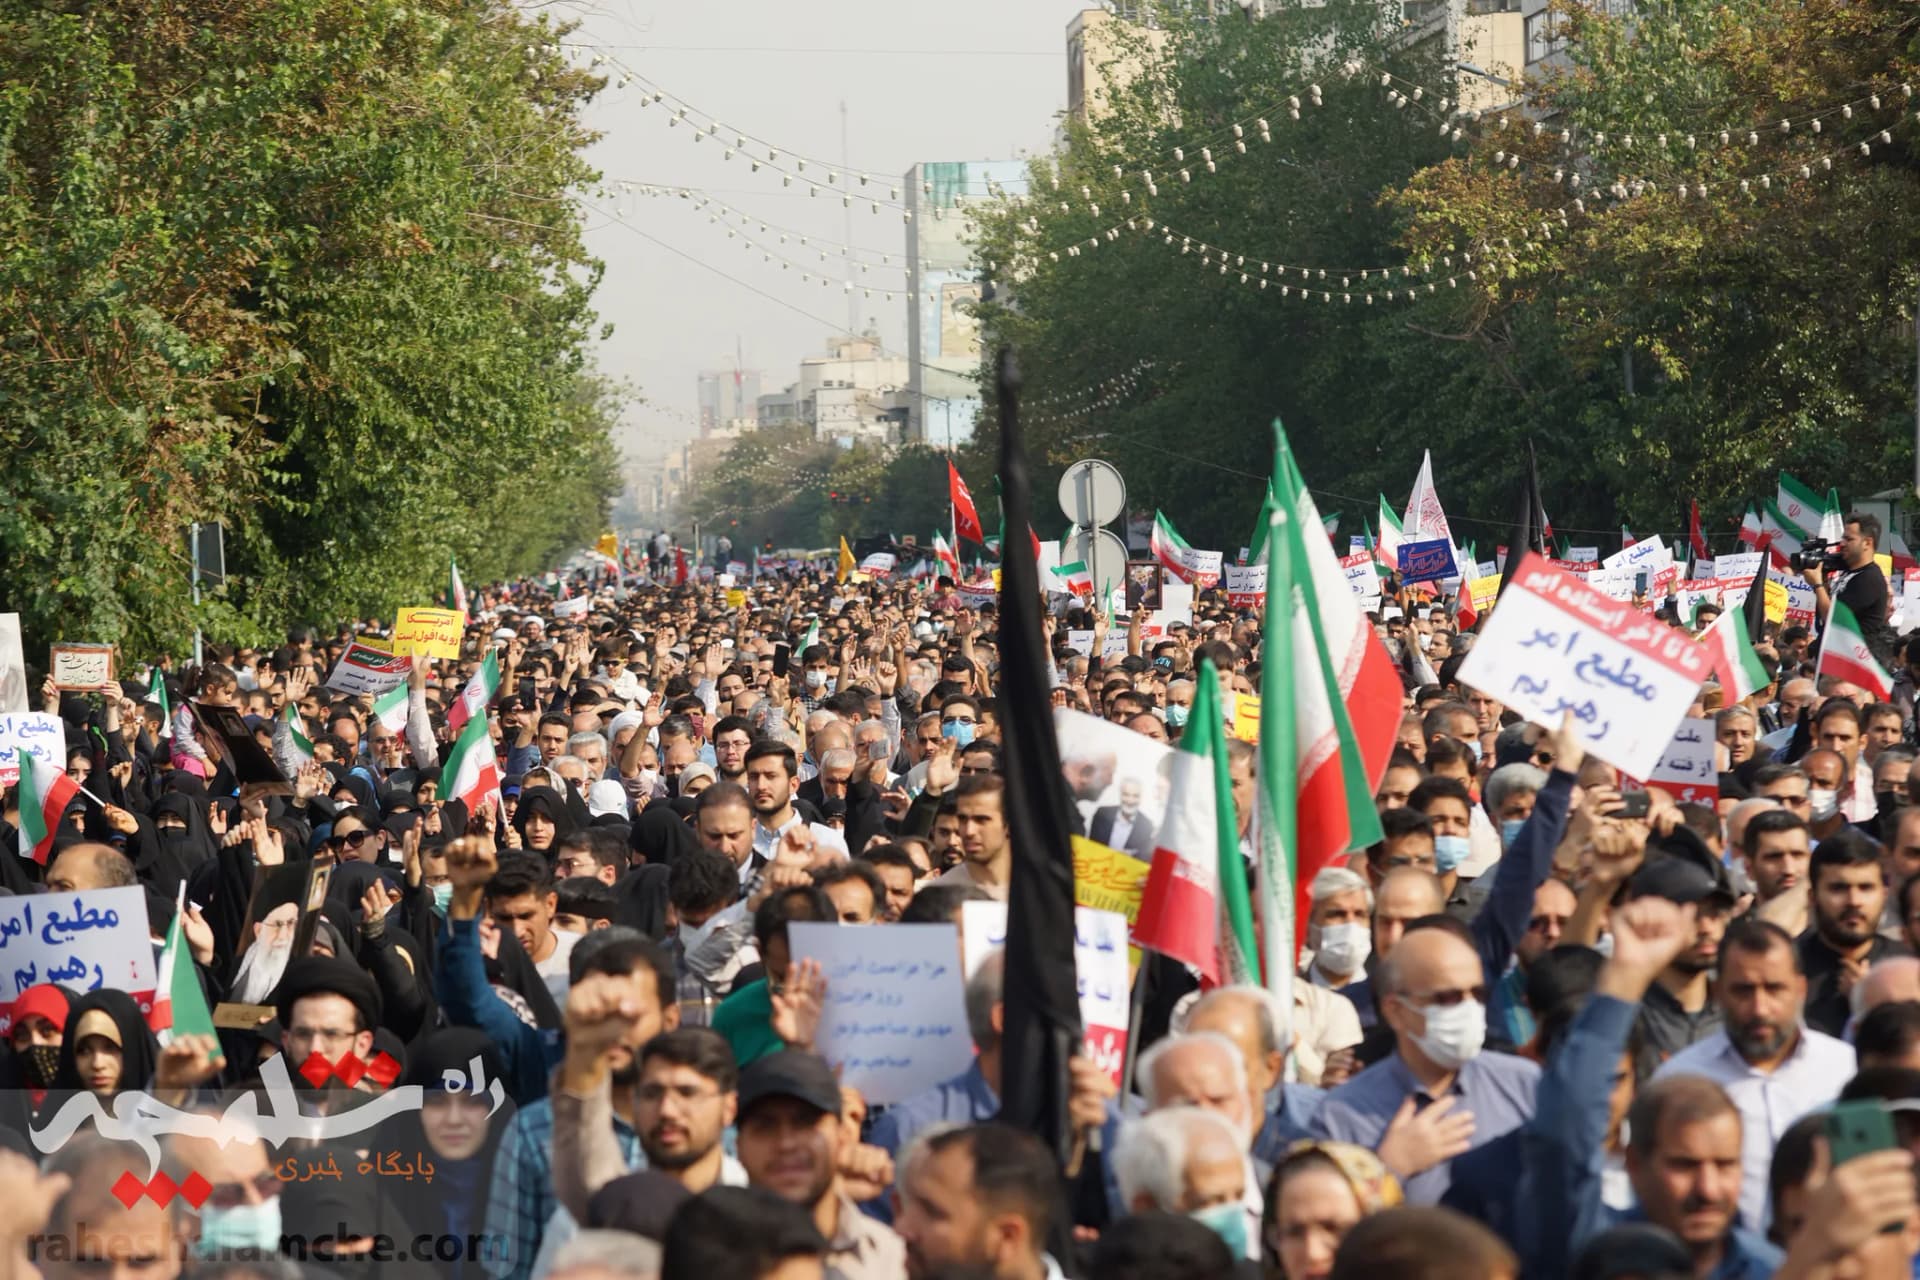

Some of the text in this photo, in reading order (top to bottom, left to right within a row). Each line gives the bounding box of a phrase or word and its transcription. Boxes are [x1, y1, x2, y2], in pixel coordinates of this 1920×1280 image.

[1524, 570, 1556, 596] ایم
[1785, 578, 1813, 593] مطیع
[1556, 588, 1626, 631] ایستاده
[396, 630, 416, 641] است
[1618, 622, 1663, 648] آخر
[1662, 636, 1681, 662] تا
[1677, 647, 1701, 671] ما
[1517, 627, 1657, 703] مطیع امر
[1674, 728, 1702, 743] ملت
[42, 897, 119, 945] مطیع
